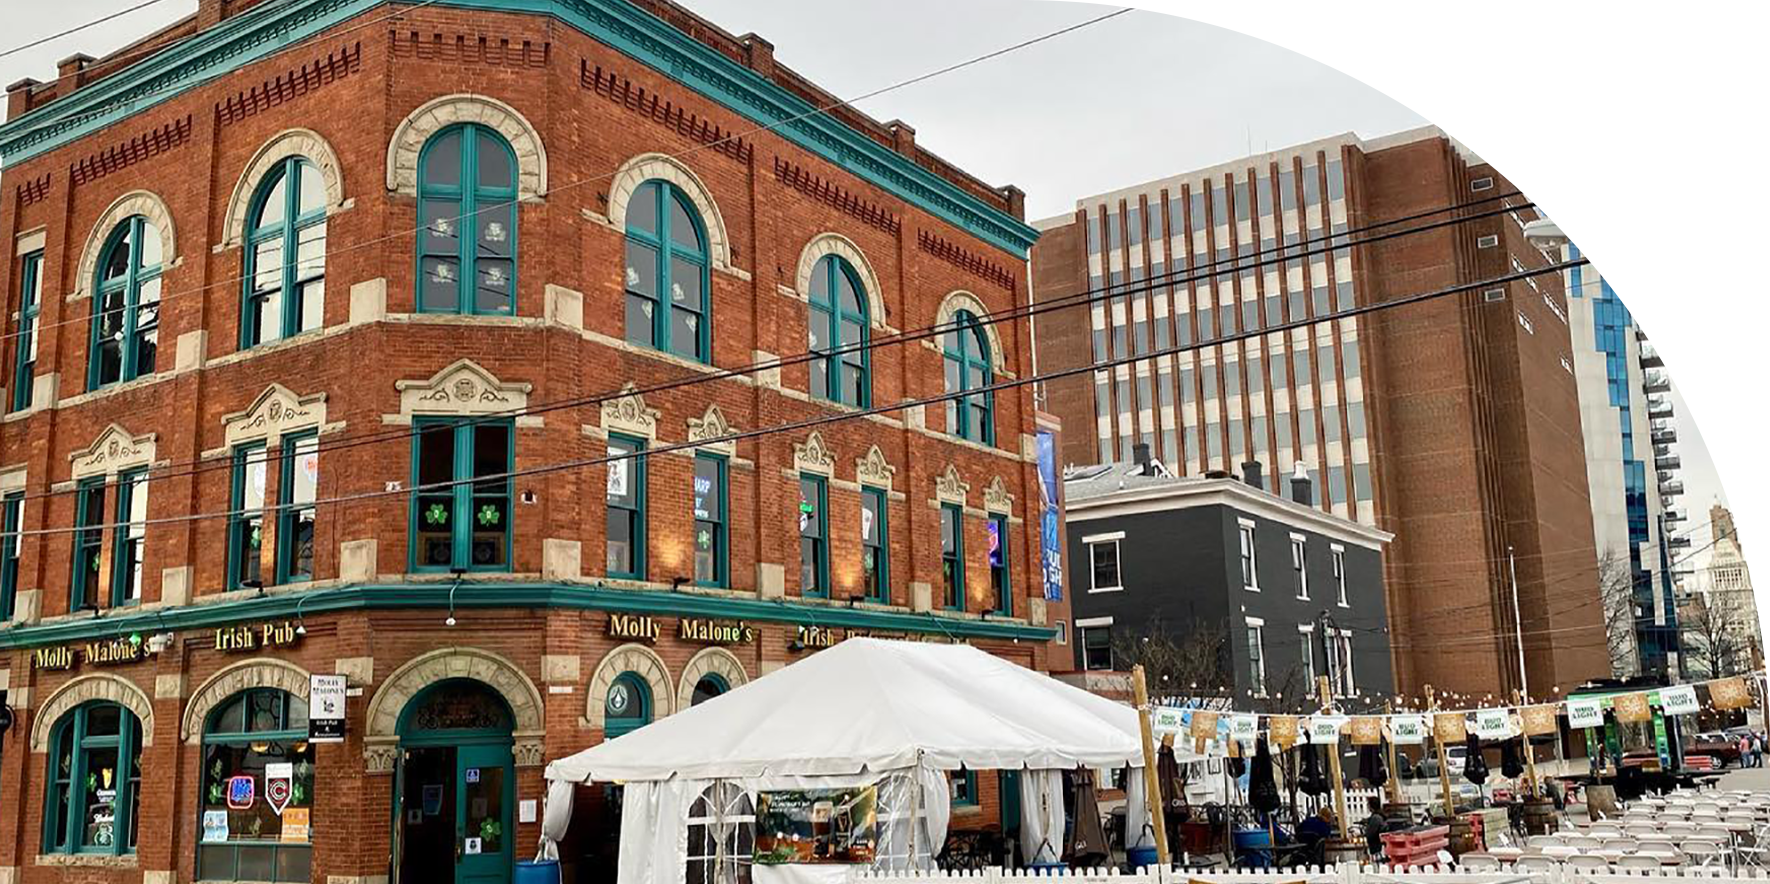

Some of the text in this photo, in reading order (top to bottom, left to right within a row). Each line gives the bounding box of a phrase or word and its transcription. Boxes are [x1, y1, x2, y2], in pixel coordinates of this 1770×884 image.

[610, 614, 753, 642] Molly Malone's
[215, 621, 294, 649] Irish Pub
[803, 627, 835, 647] Irish
[35, 646, 74, 669] Molly
[1665, 697, 1694, 708] LIGHT
[1571, 709, 1598, 721] LIGHT
[1157, 718, 1178, 726] LIGHT
[1481, 722, 1505, 731] LIGHT
[1233, 725, 1255, 733] LIGHT
[1313, 728, 1336, 737] LIGHT
[1395, 728, 1419, 736] LIGHT
